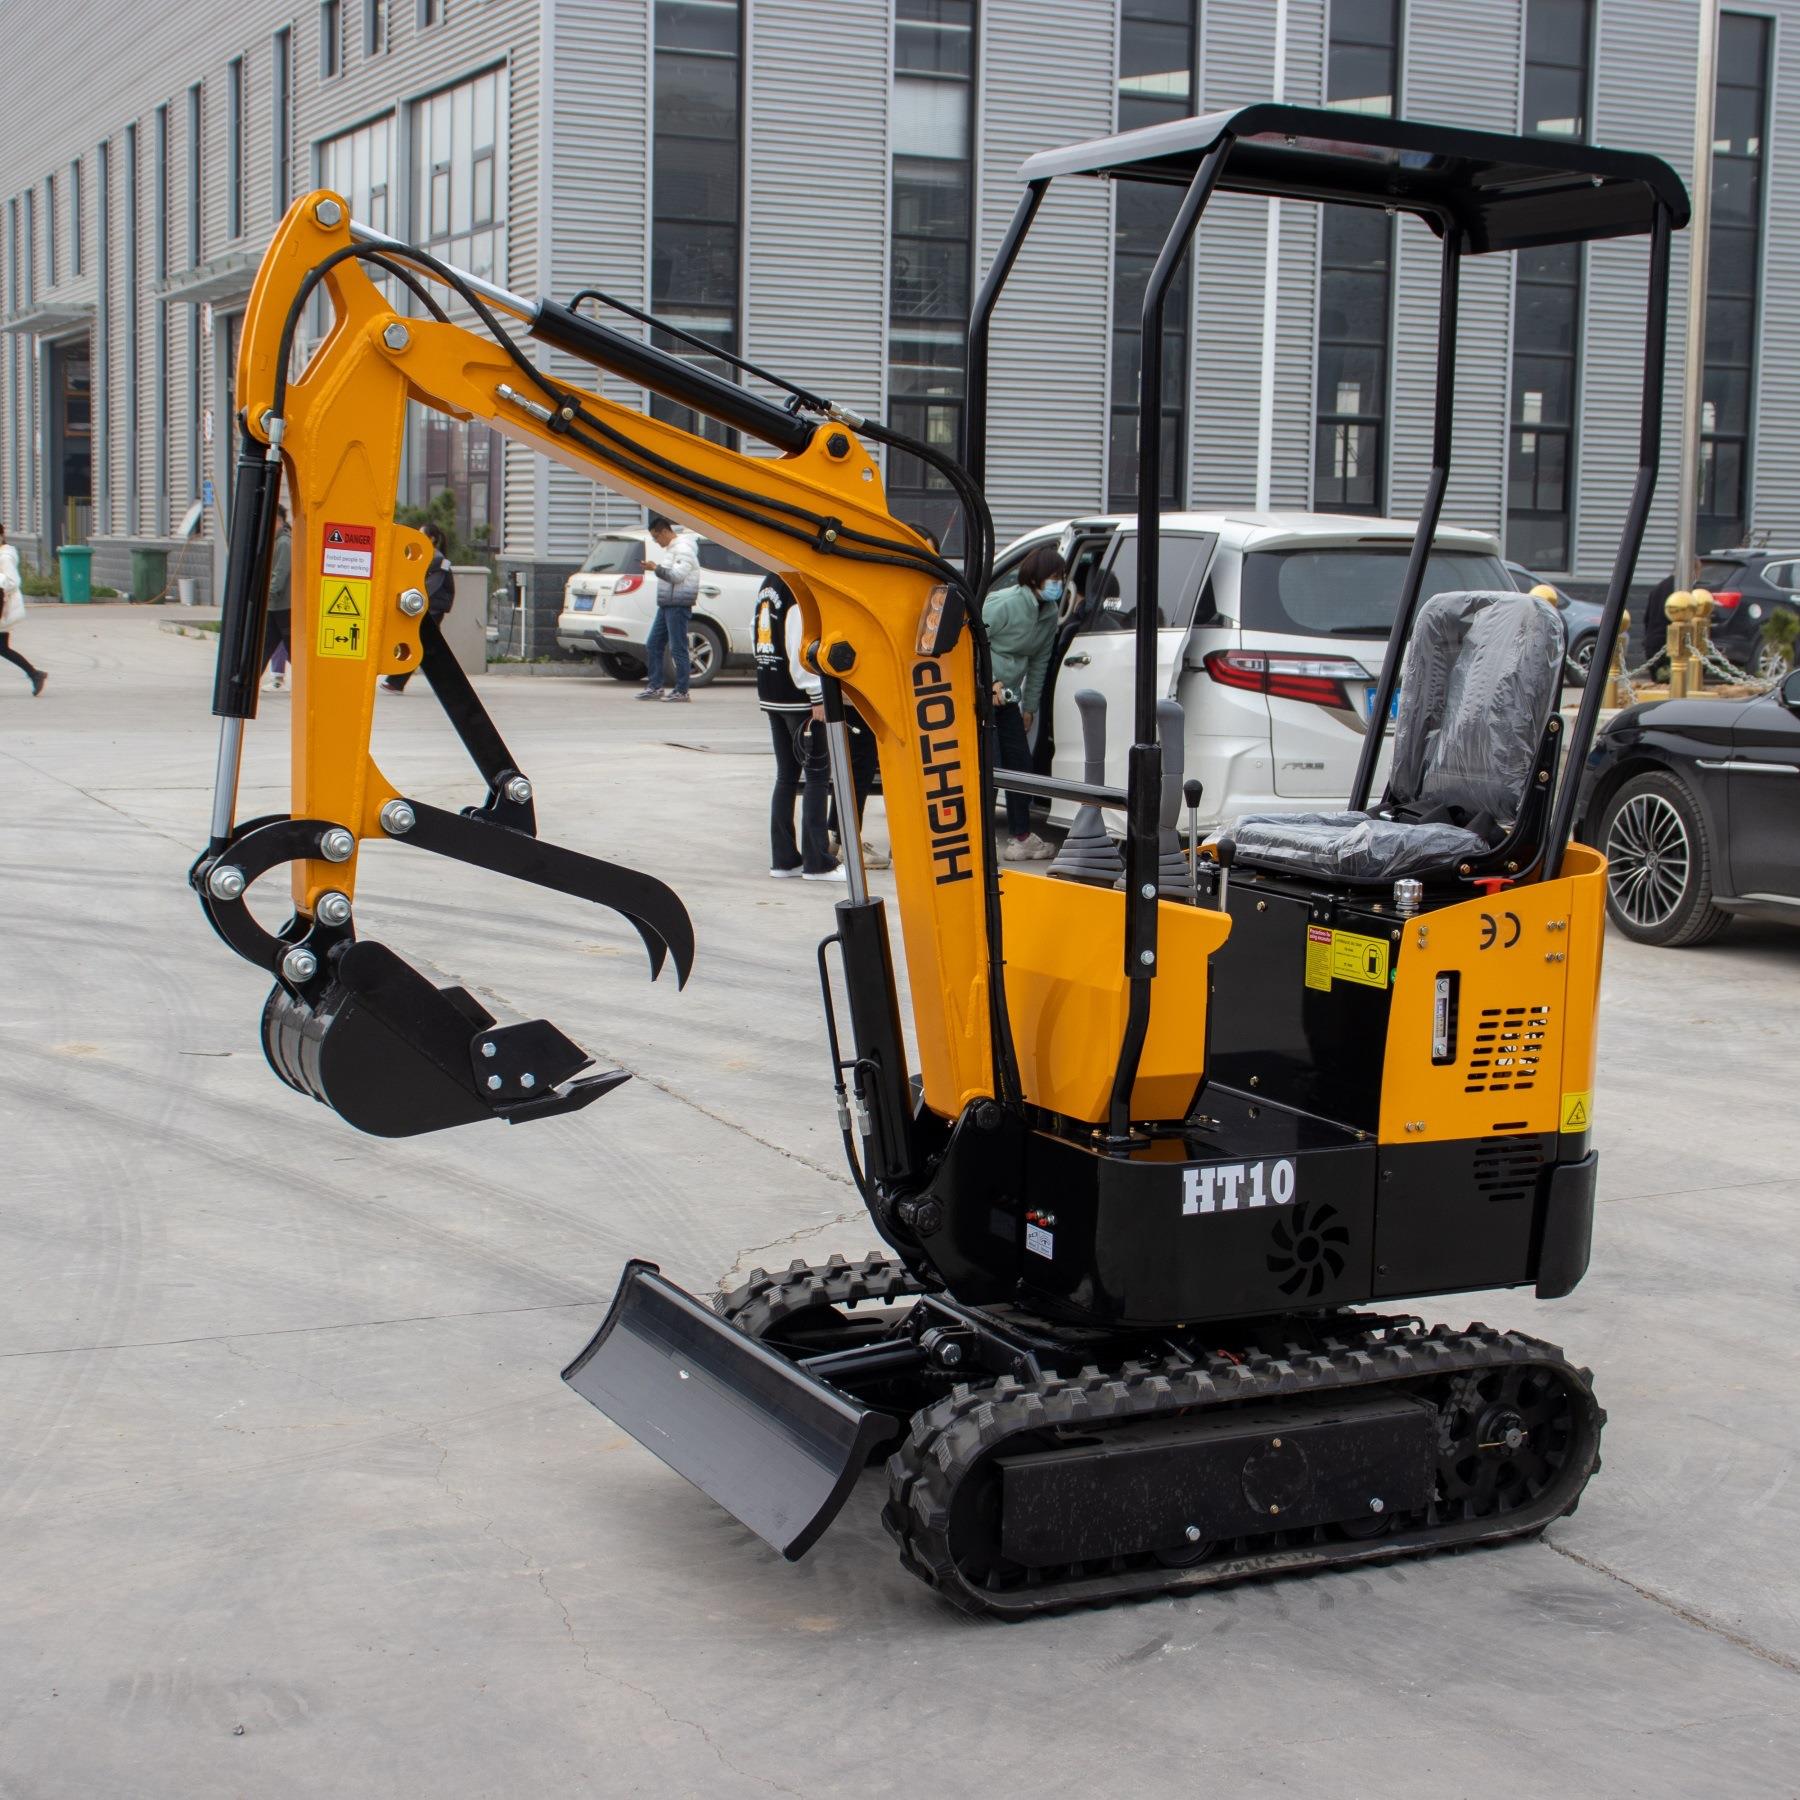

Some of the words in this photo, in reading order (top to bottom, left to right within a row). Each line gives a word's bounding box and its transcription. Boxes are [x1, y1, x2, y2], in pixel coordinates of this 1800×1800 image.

[344, 533, 371, 545] DANGER
[912, 660, 974, 886] HIGHTOP
[1182, 1159, 1295, 1215] HT10
